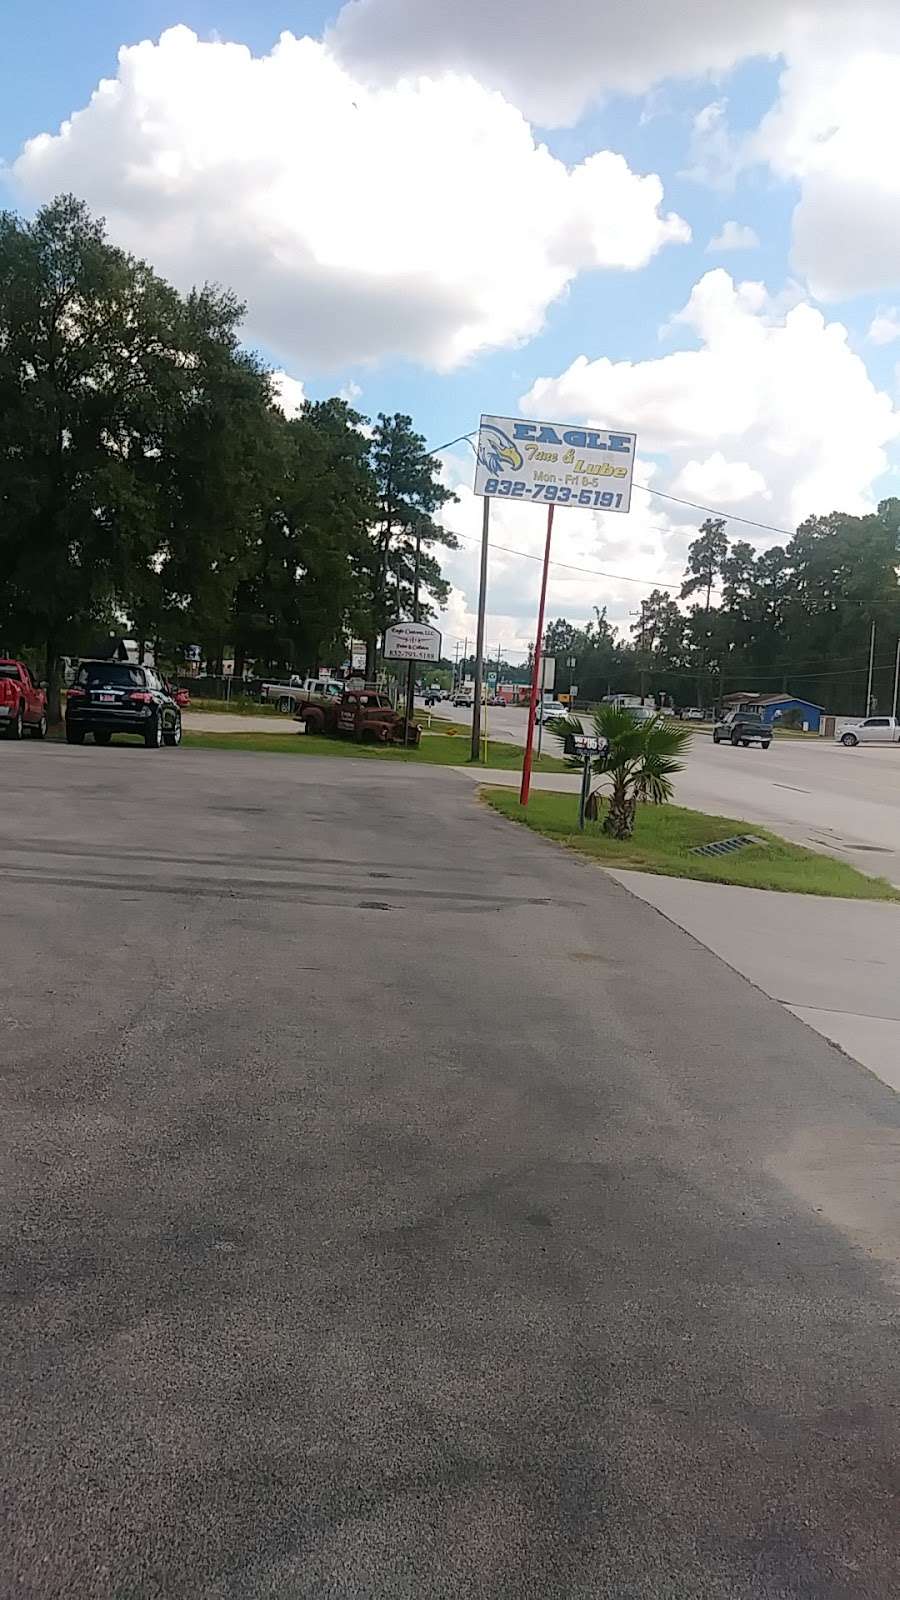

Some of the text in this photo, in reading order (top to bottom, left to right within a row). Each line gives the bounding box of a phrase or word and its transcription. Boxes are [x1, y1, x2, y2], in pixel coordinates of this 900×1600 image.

[513, 423, 631, 454] EAGLE
[533, 470, 556, 483] Mon
[565, 474, 579, 486] Fri
[562, 448, 576, 464] &
[573, 459, 628, 478] Lube
[484, 478, 623, 509] 832-793-5191
